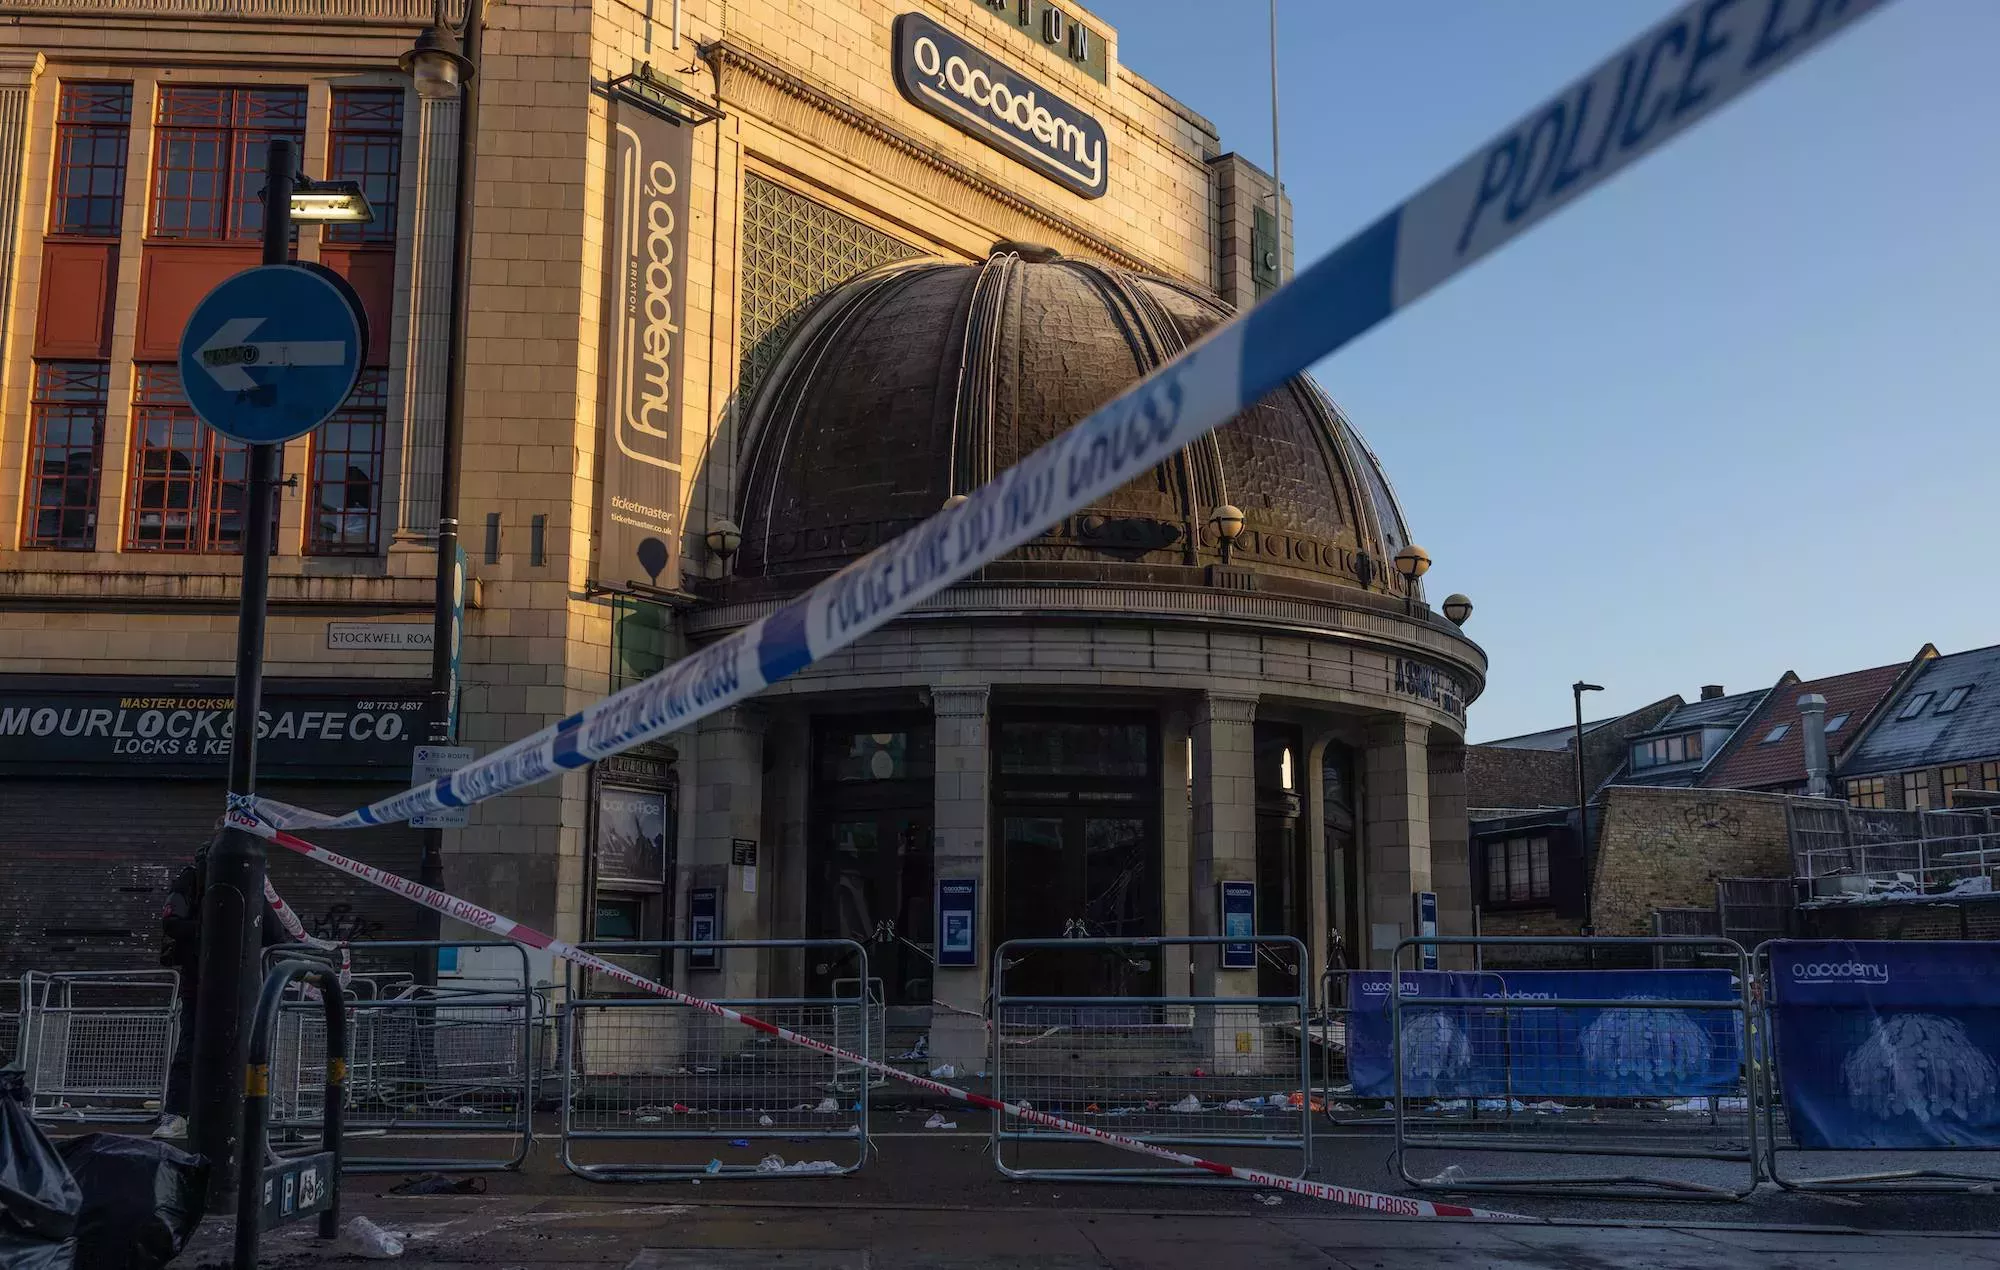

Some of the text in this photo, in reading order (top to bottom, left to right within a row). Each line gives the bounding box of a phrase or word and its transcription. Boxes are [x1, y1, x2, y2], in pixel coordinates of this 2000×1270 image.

[1456, 0, 1738, 256] POLICE
[630, 261, 638, 314] BRIXTON
[611, 495, 673, 521] ticketmaster
[611, 513, 672, 535] ticketmaster.co.uk
[332, 632, 403, 643] STOCKWELL
[120, 698, 175, 709] MASTER
[357, 701, 375, 710] 020
[376, 701, 399, 711] 7733
[113, 738, 180, 754] LOCKS
[185, 738, 198, 754] &
[447, 752, 470, 760] ROUTE
[628, 800, 660, 816] office
[1327, 1188, 1344, 1203] DO
[1348, 1192, 1373, 1209] NOT
[1376, 1196, 1419, 1216] CROSS
